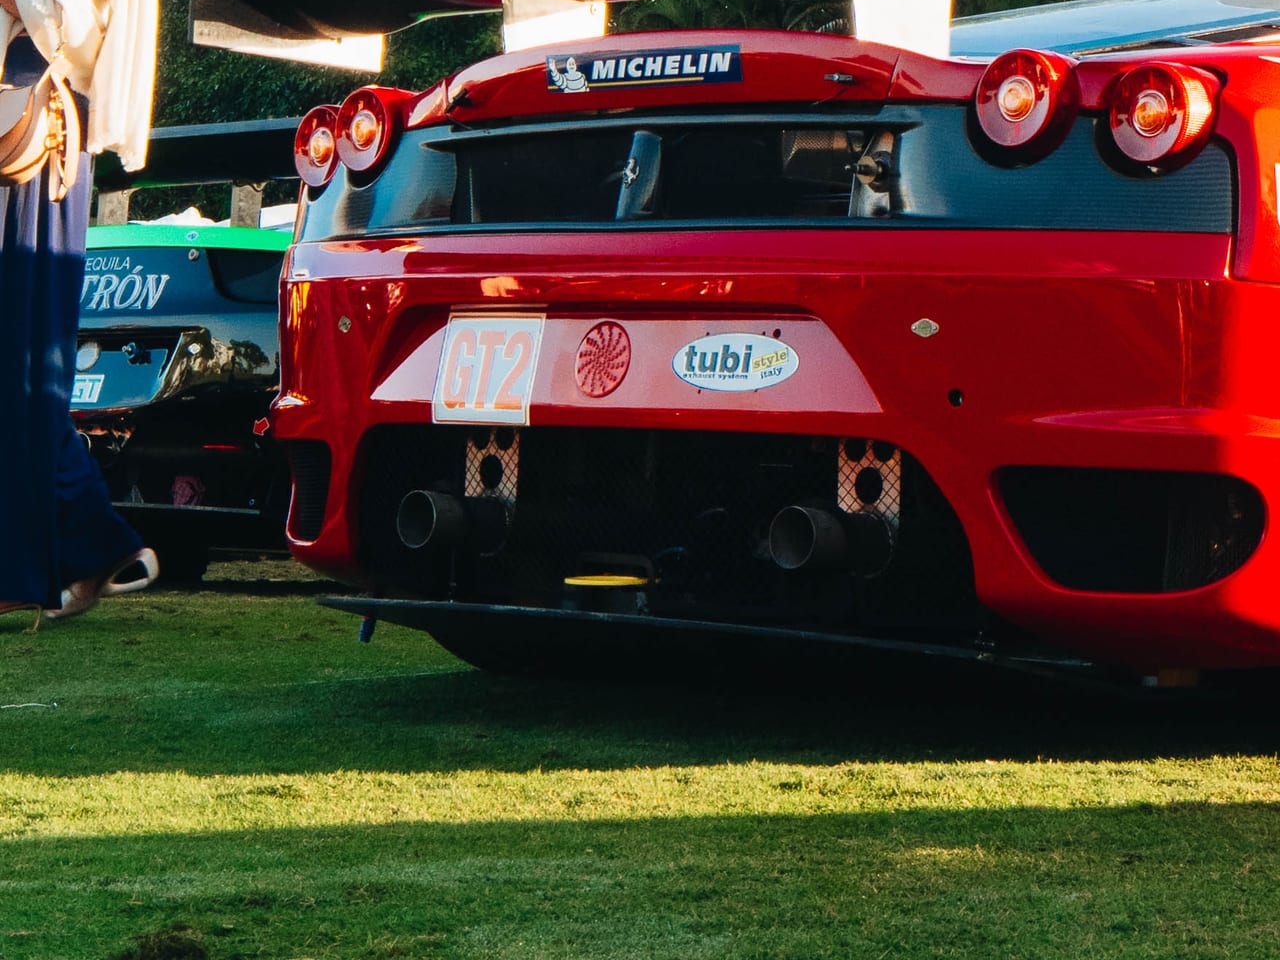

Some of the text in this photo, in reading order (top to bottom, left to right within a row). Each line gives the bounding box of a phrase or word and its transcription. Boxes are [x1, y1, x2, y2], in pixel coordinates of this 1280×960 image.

[592, 52, 731, 80] MICHELIN
[85, 256, 131, 271] EQUILA
[80, 265, 170, 312] TRÓN
[446, 328, 533, 410] GT2
[685, 345, 789, 373] tubi style
